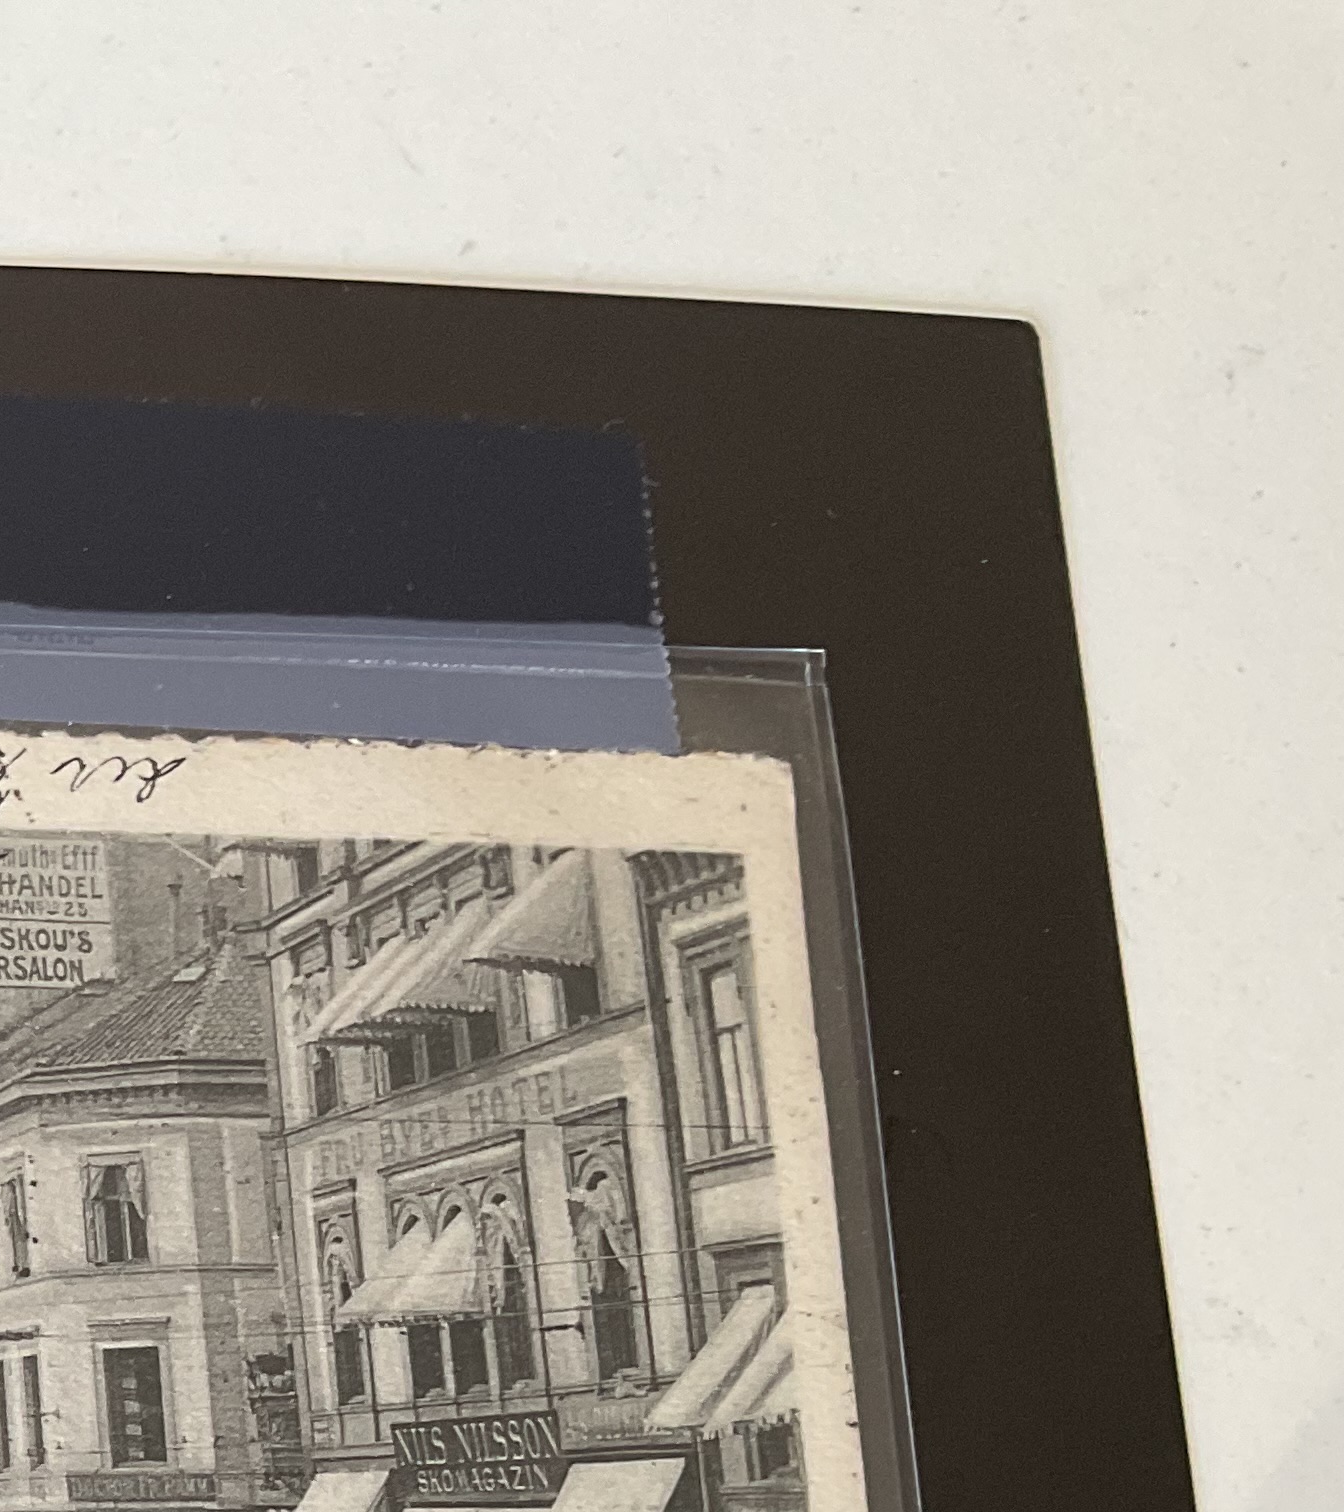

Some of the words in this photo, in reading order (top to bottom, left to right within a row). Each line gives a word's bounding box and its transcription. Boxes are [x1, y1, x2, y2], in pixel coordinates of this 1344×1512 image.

[63, 900, 90, 917] 25
[394, 1426, 448, 1467] NILS
[453, 1416, 561, 1464] NILSSON
